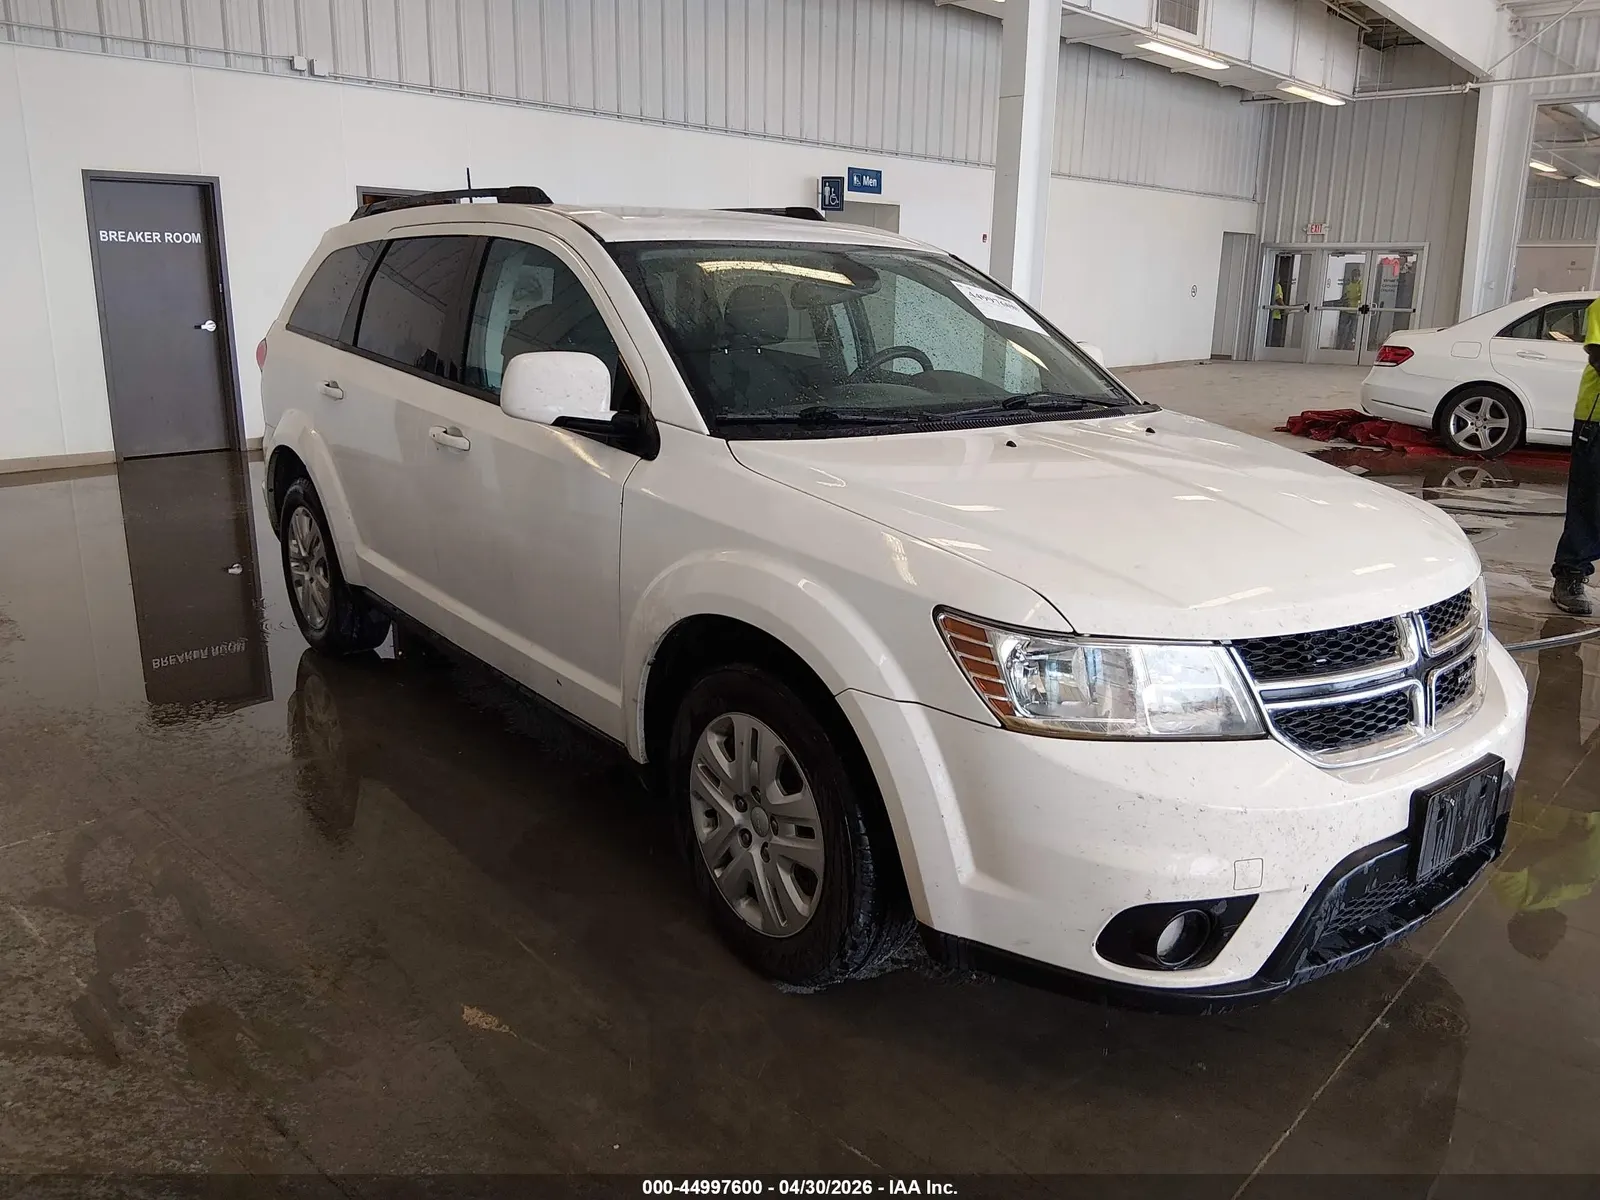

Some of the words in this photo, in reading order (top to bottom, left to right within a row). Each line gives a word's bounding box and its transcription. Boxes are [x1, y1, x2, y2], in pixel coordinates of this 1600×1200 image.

[862, 175, 877, 187] Men
[1310, 224, 1322, 233] EXIT
[99, 230, 162, 243] BREAKER
[164, 232, 202, 244] ROOM
